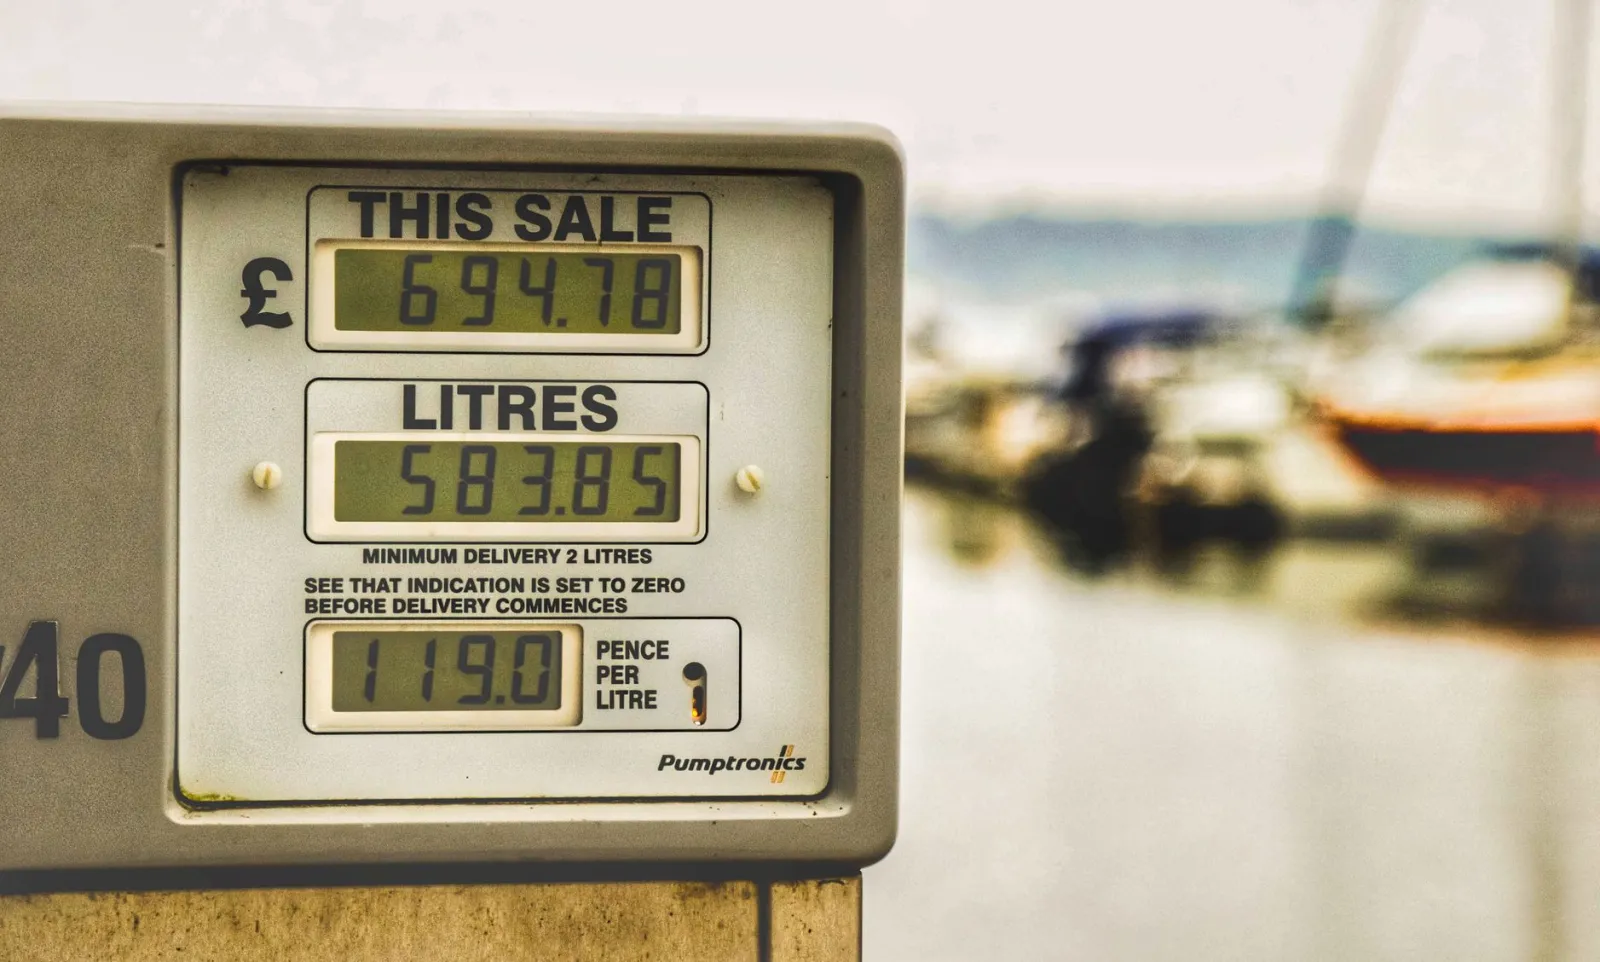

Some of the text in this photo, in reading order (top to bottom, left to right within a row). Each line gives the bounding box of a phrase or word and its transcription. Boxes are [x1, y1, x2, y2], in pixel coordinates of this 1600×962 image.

[348, 192, 672, 243] THIS SALE
[240, 257, 294, 329] £
[400, 255, 672, 329] 694.78
[403, 384, 618, 432] LITRES
[401, 445, 667, 516] 583.85
[362, 549, 652, 565] MINIMUM DELIVERY 2 LITRES
[304, 578, 685, 594] SEE THAT INDICATION IS SET TO ZERO
[305, 598, 628, 614] BEFORE DELIVERY COMMENCES
[597, 640, 669, 660] PENCE
[364, 635, 552, 705] 119.0
[597, 666, 639, 685] PER
[597, 691, 657, 710] LITRE
[657, 744, 807, 777] Pumptronics
